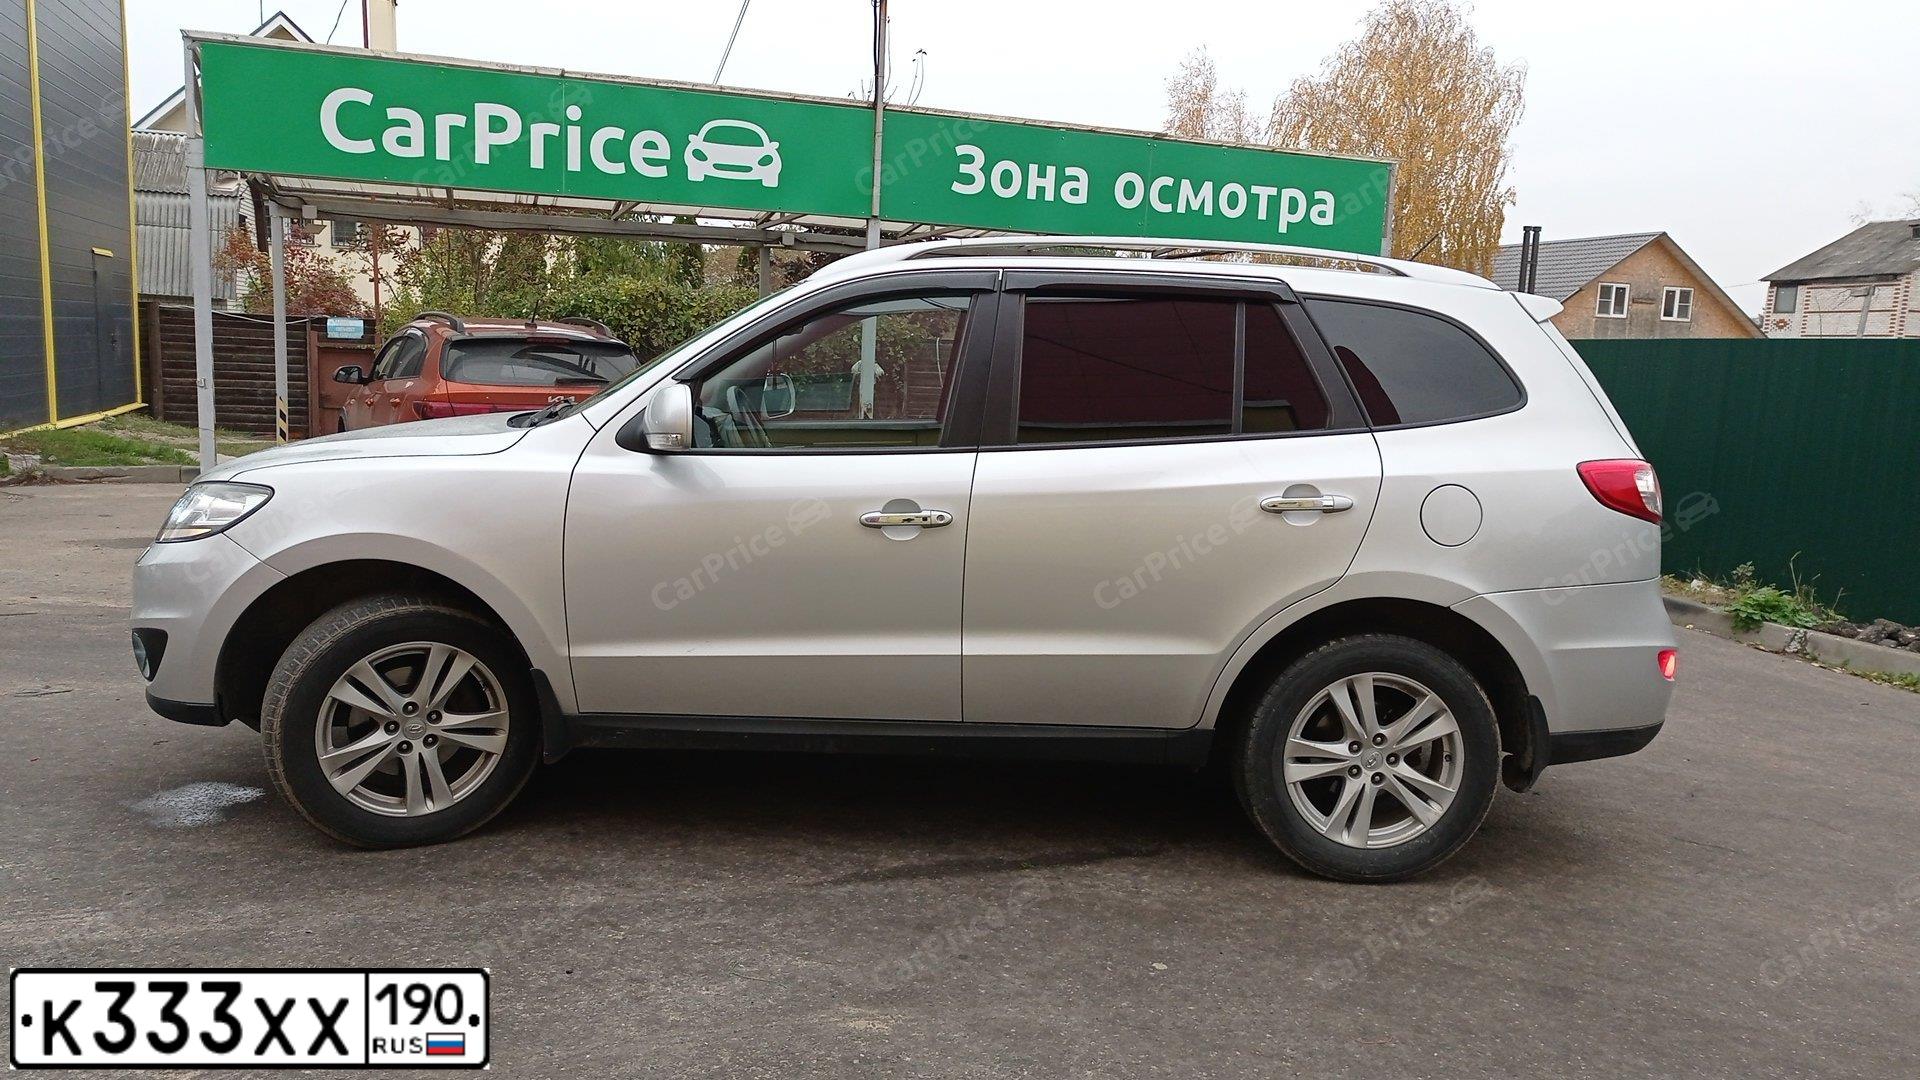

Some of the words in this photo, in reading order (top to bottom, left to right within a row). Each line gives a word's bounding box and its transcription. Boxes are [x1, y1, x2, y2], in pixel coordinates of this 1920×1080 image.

[319, 87, 671, 177] CarPrice
[951, 144, 1089, 205] Зона
[1114, 171, 1335, 233] осмотра
